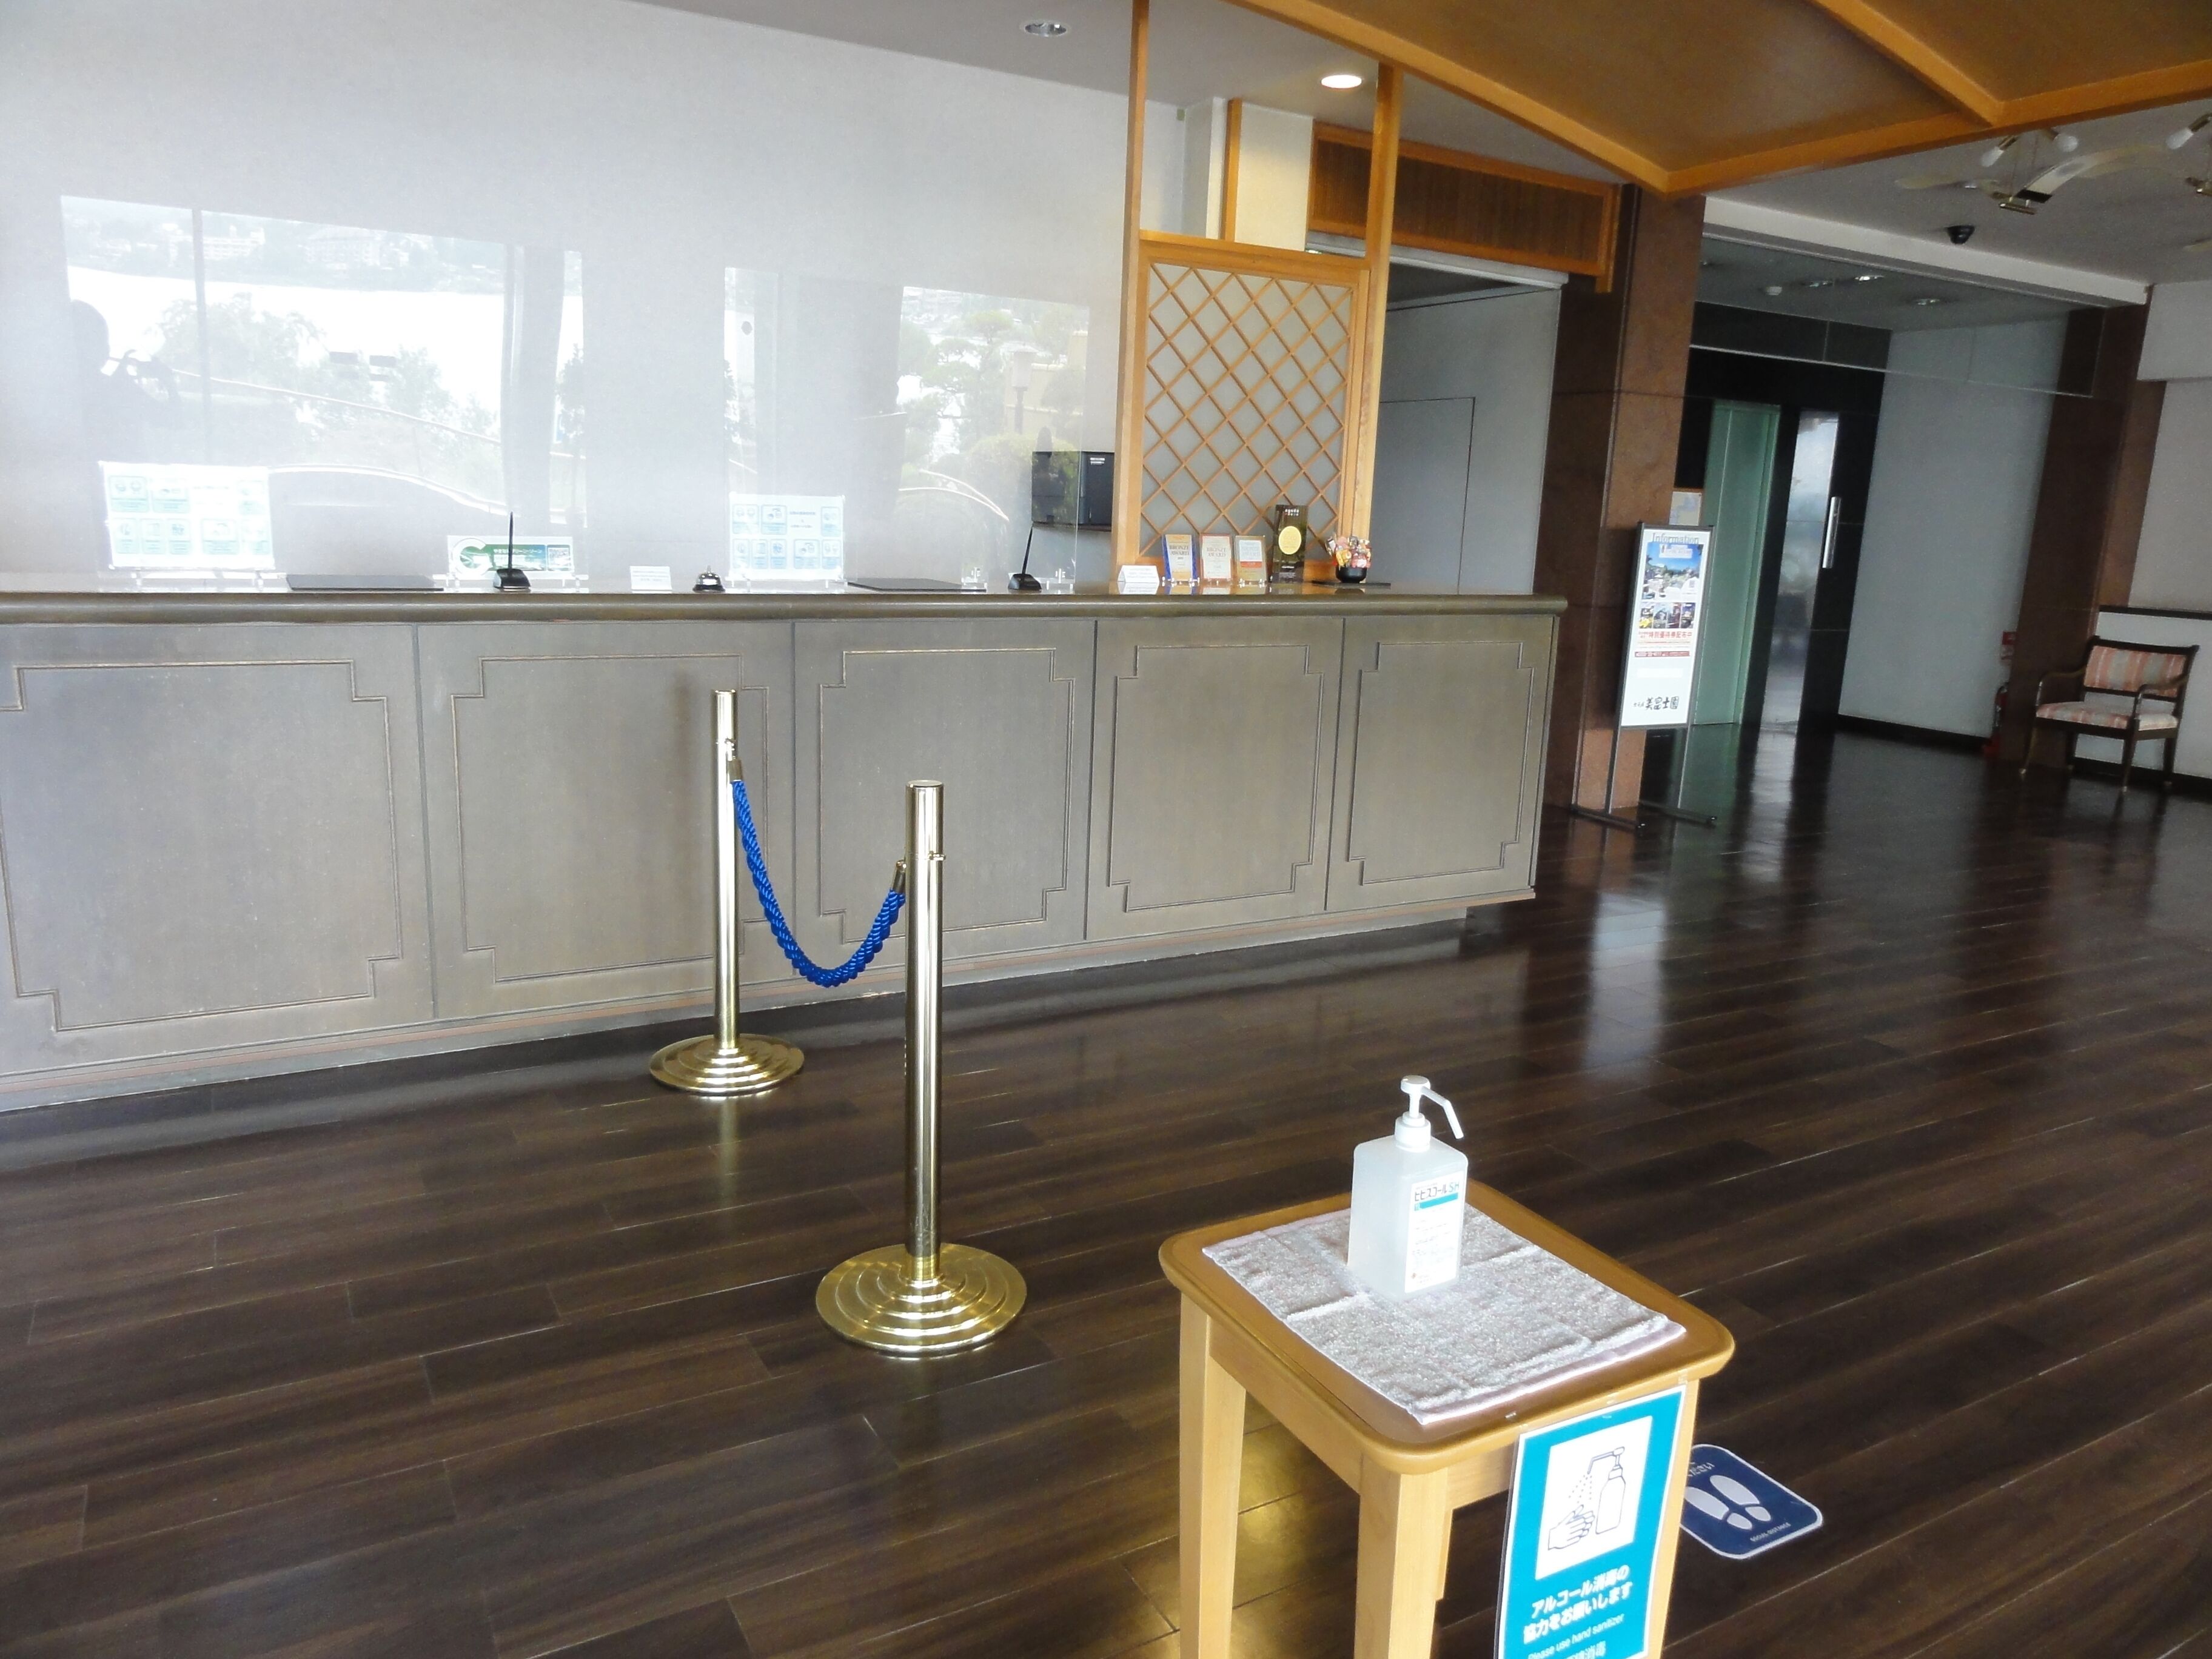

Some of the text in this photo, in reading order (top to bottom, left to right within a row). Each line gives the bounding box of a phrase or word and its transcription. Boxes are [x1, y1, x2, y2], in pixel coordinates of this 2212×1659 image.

[1652, 533, 1700, 544] Information
[1532, 1564, 1630, 1618] アルコール消毒の
[1556, 1638, 1571, 1652] use
[1572, 1626, 1592, 1644] hand
[1592, 1613, 1625, 1635] sanitizer
